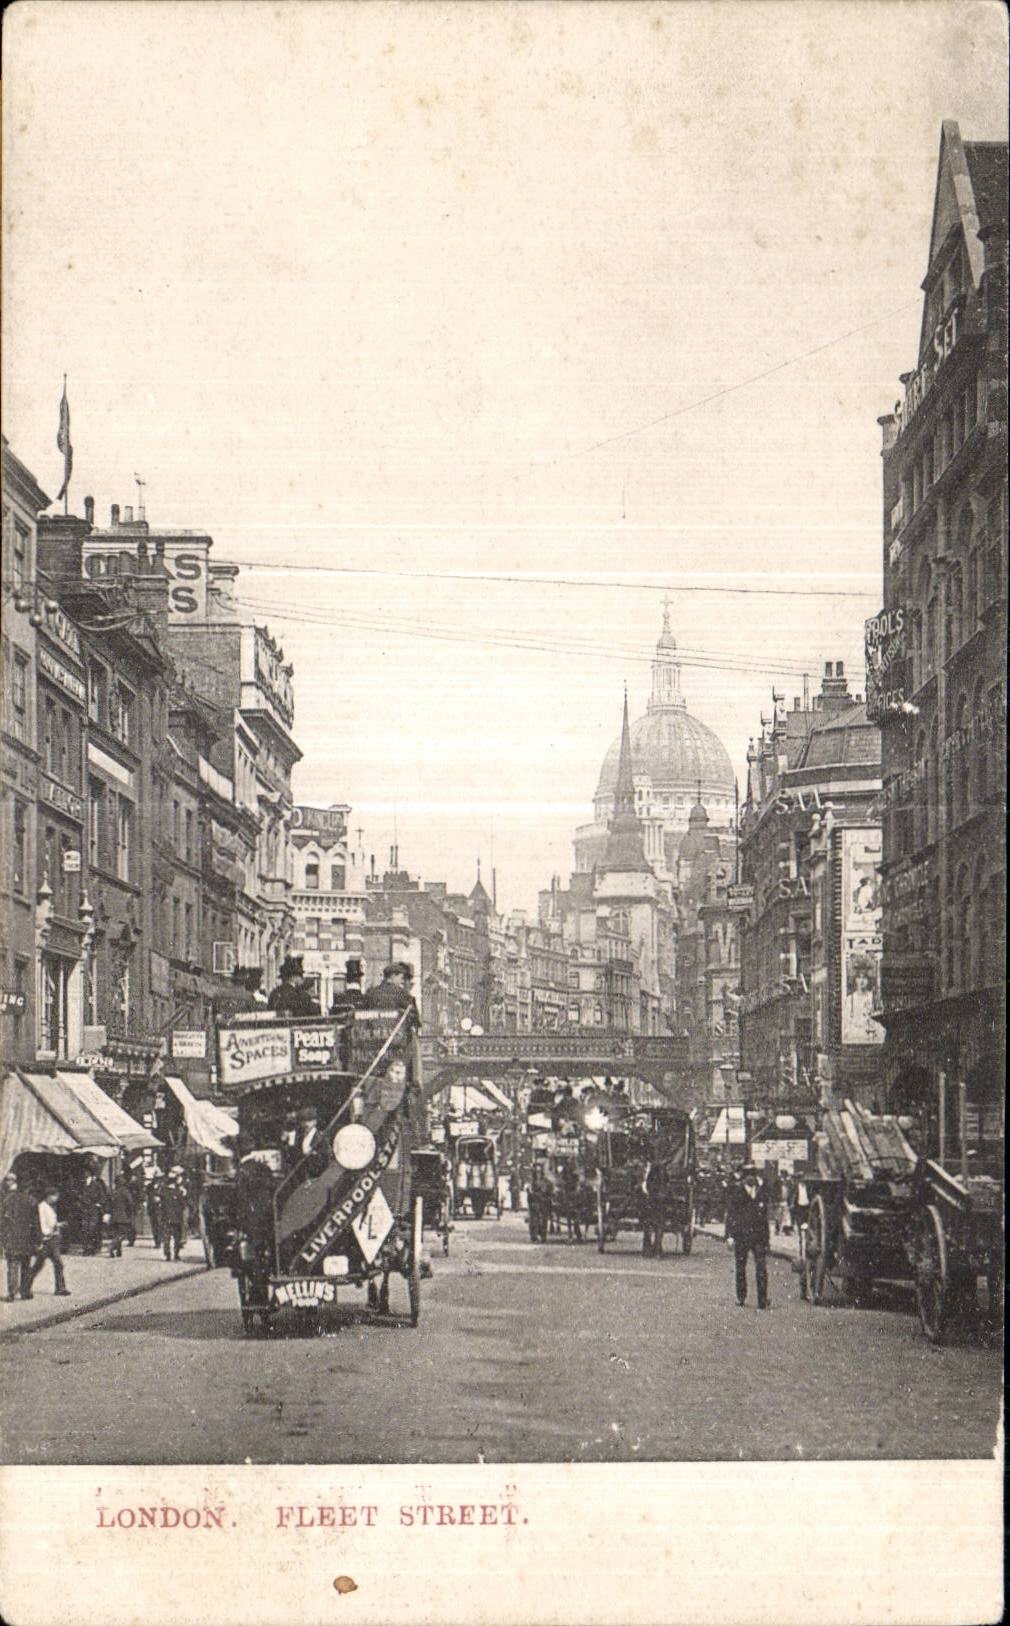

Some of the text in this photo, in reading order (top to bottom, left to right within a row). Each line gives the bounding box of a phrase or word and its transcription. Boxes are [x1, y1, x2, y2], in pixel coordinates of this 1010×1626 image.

[230, 1045, 288, 1070] SPACES
[299, 1048, 331, 1065] Soap
[301, 1169, 382, 1263] LIVERPOOL
